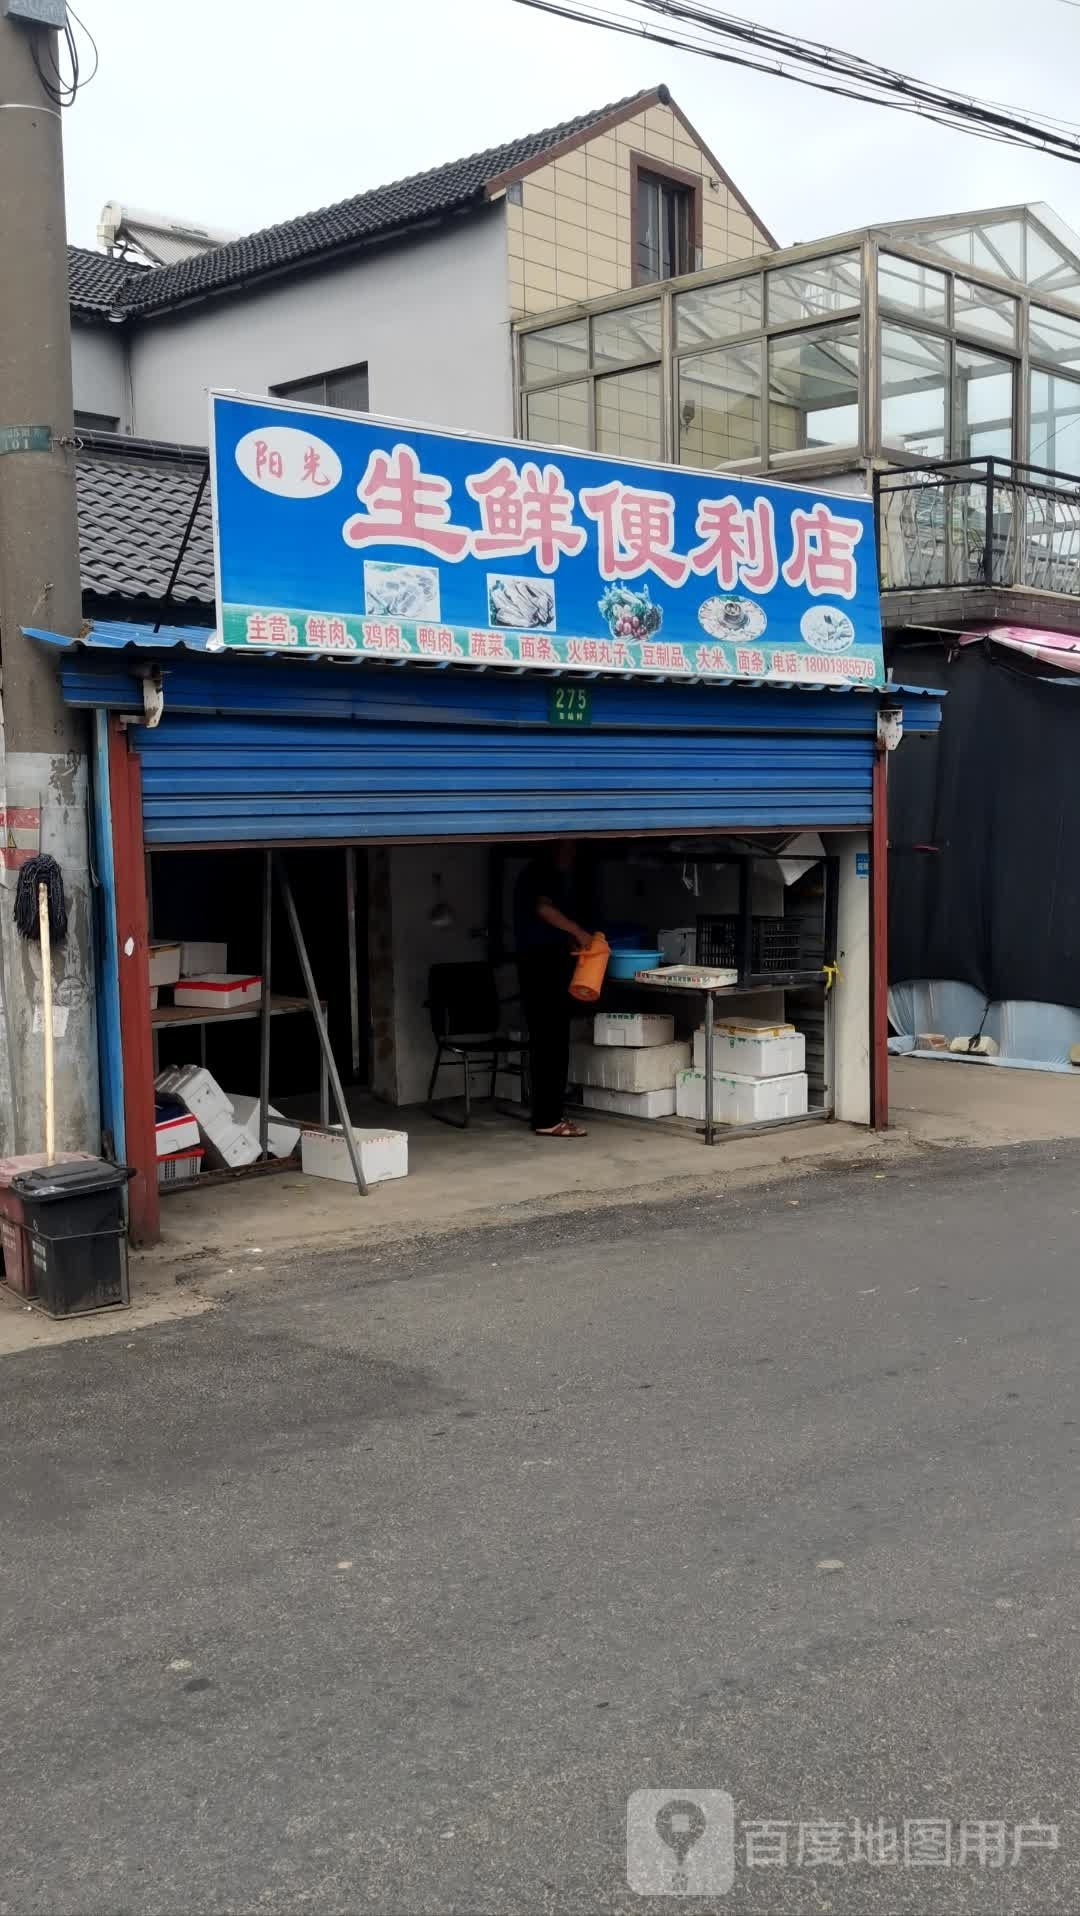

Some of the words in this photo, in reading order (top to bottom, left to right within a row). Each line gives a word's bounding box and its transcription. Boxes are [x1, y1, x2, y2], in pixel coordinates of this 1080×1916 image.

[253, 439, 331, 487] 阳光
[344, 446, 862, 597] 生鲜便利店
[556, 688, 587, 709] 275
